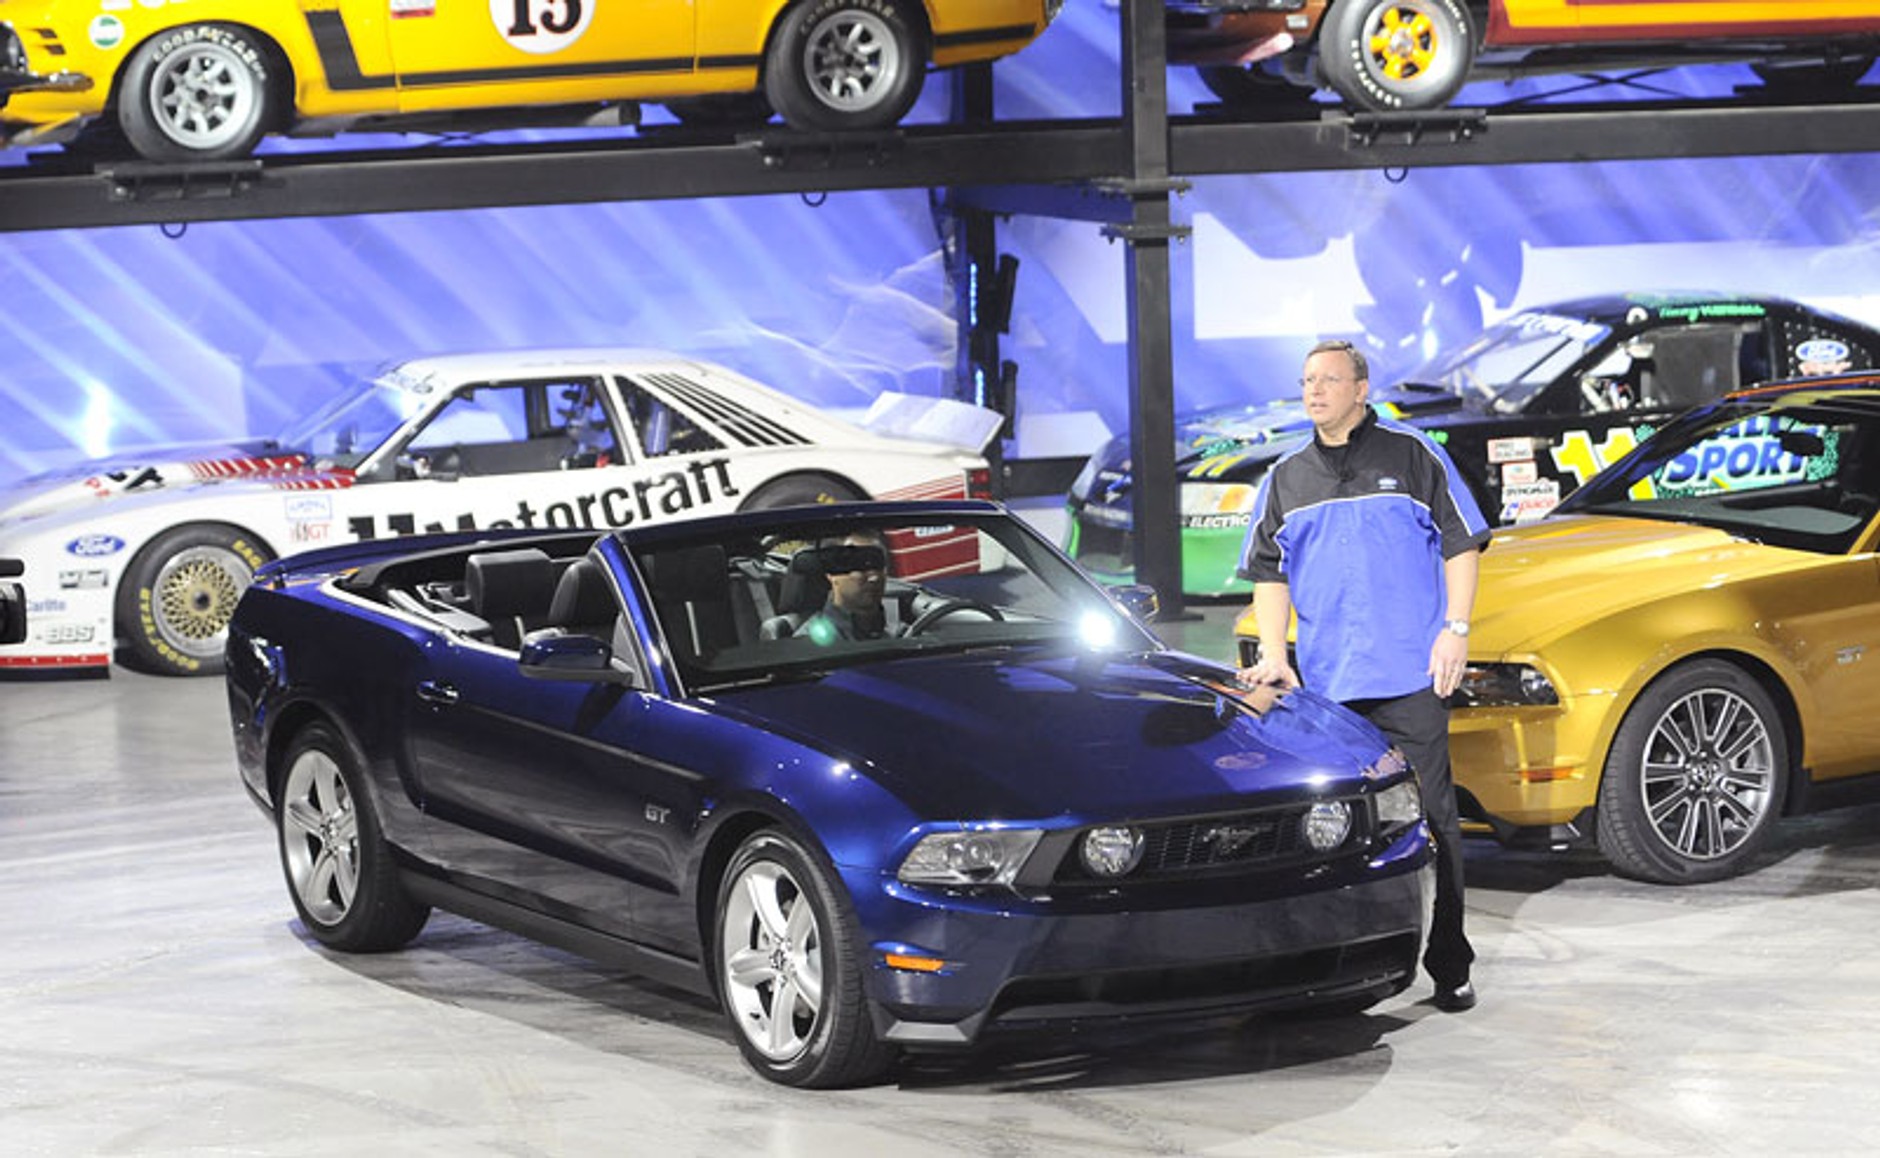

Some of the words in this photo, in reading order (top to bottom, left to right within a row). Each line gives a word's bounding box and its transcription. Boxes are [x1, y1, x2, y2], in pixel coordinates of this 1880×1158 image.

[424, 458, 740, 531] torcraft
[75, 535, 116, 555] Ford
[645, 803, 671, 824] GT
